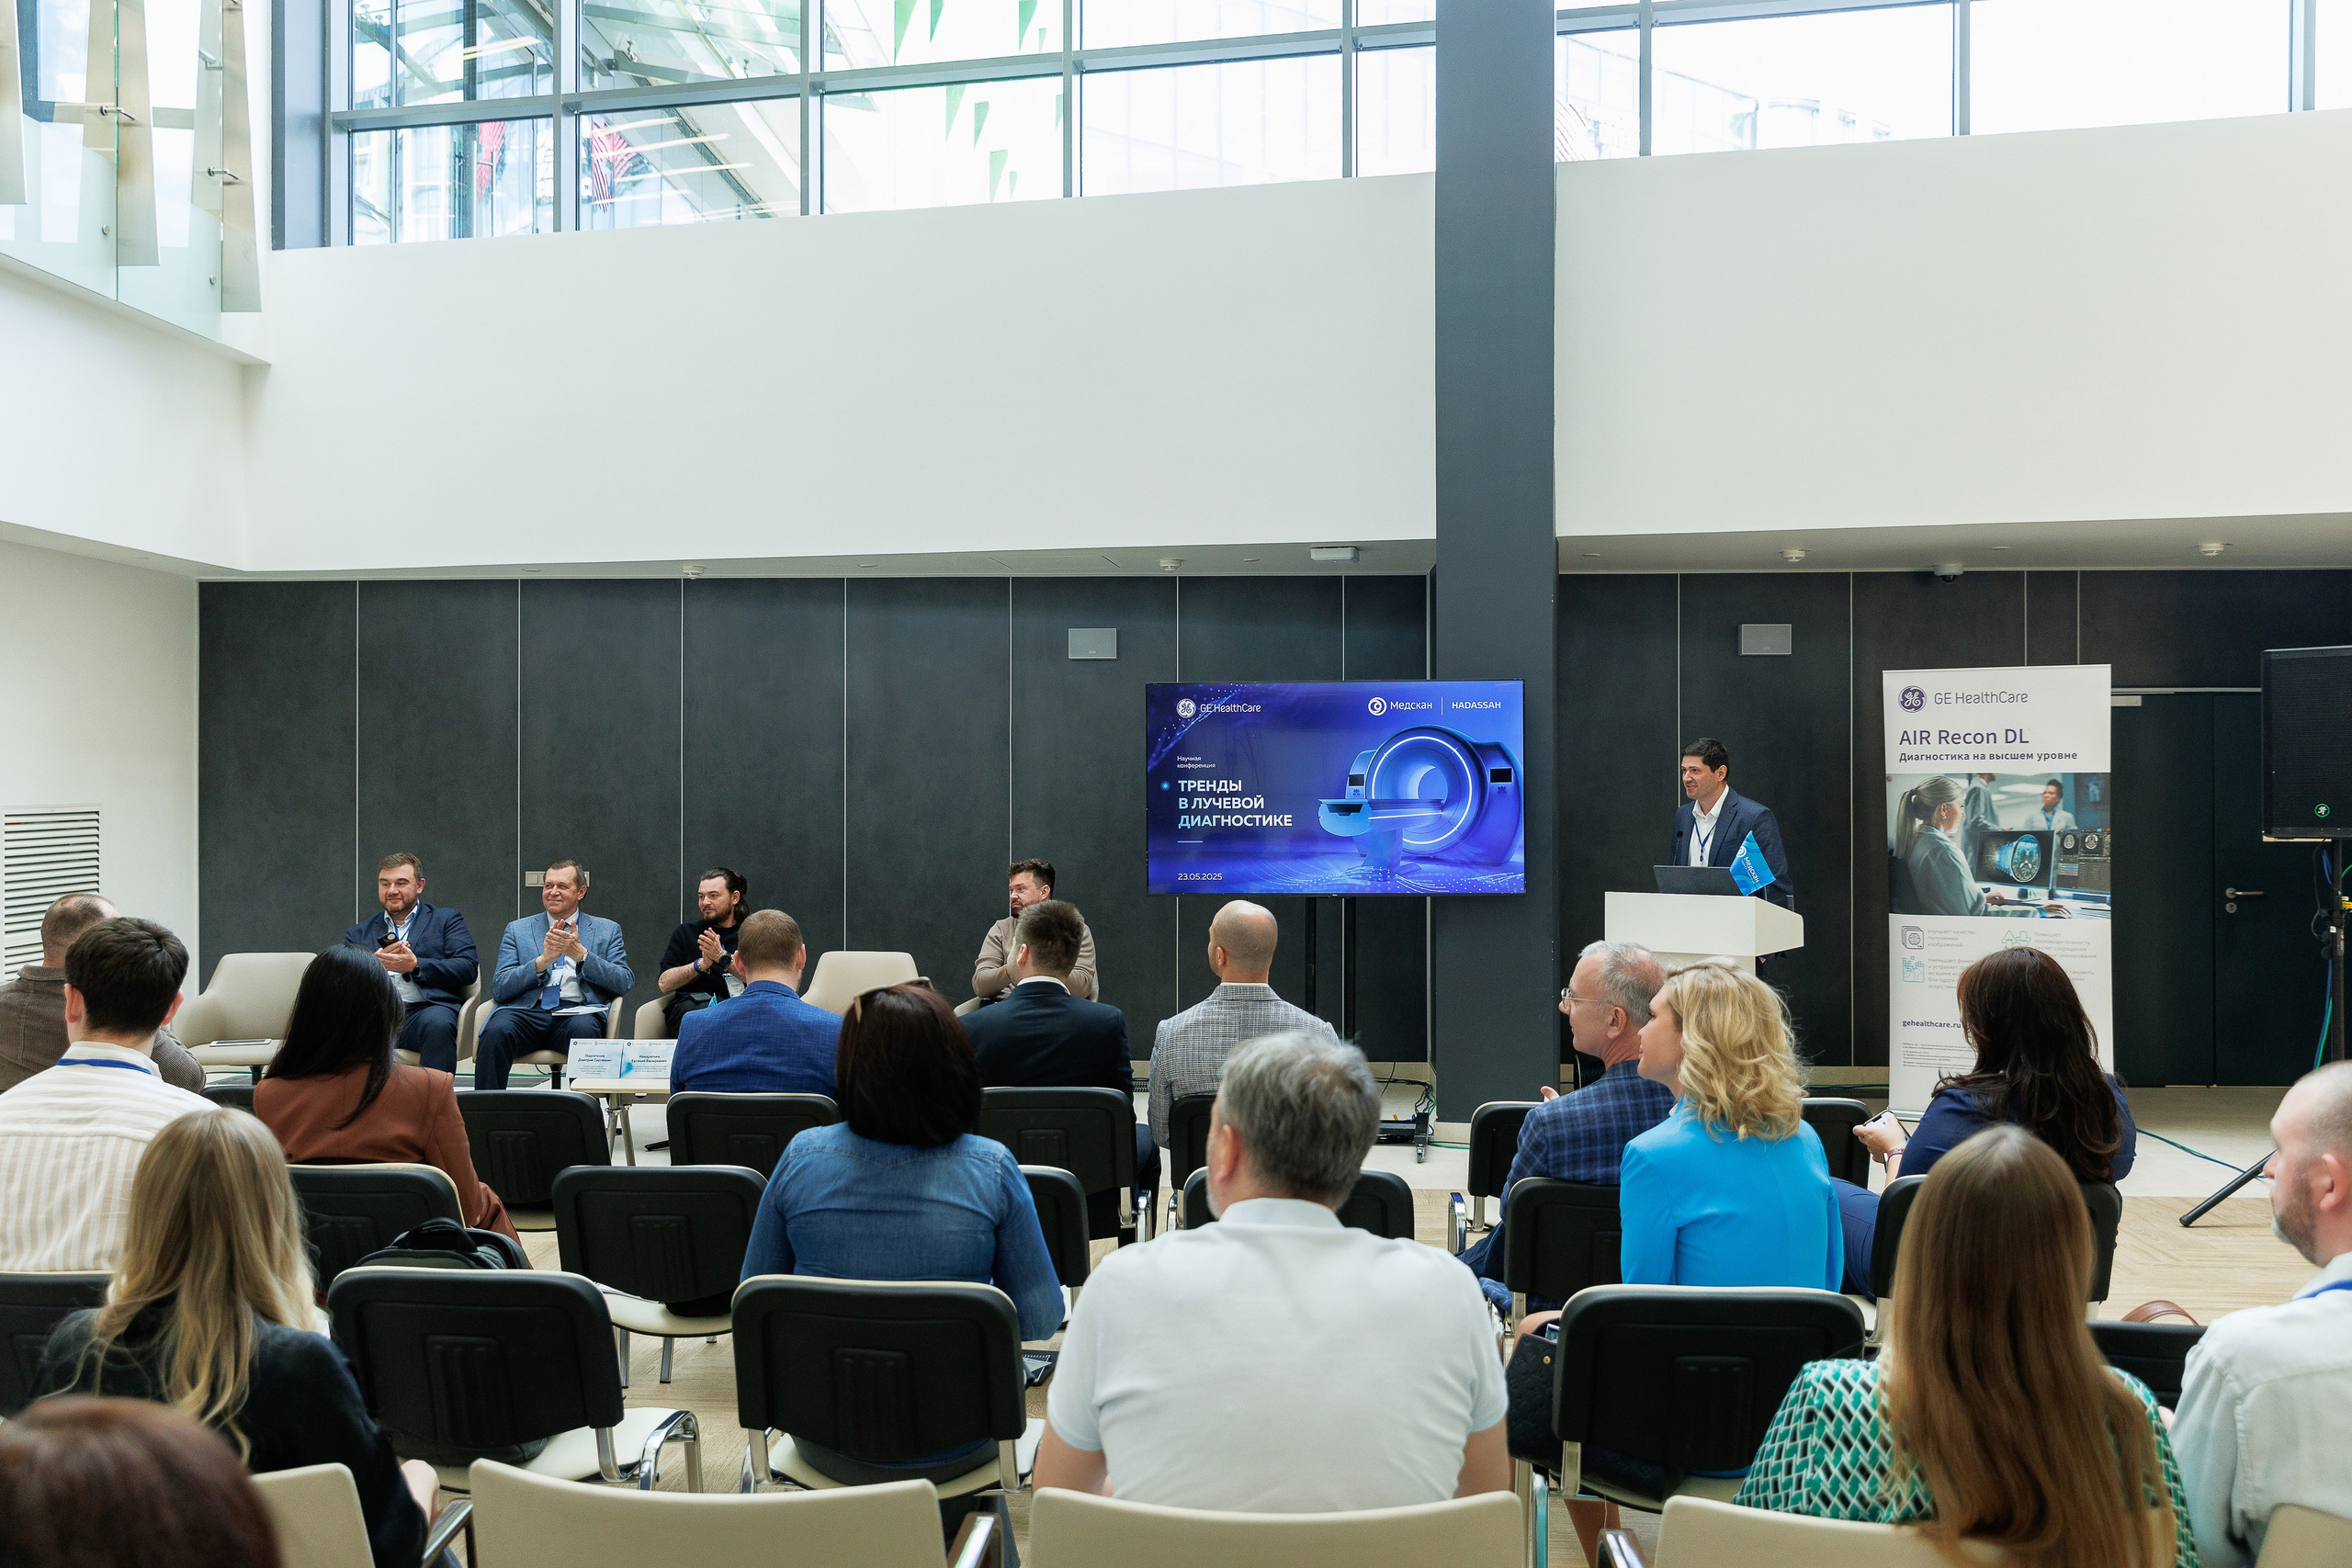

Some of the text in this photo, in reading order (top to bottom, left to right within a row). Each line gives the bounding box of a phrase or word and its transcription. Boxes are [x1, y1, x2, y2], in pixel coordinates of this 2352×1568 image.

[1934, 691, 2029, 705] GE HealthCare
[1200, 703, 1261, 713] GE HealthCare
[1390, 701, 1433, 711] Медскан
[1452, 701, 1501, 709] HADASSAH
[1899, 728, 2030, 745] AIR Recon DL
[1899, 752, 1970, 762] Диагностика
[1989, 752, 2034, 761] высшем
[2037, 751, 2078, 761] уровне
[1178, 780, 1242, 794] ТРЕНДЫ
[1179, 795, 1265, 809] В ЛУЧЕВОЙ
[1178, 815, 1293, 829] ДИАГНОСТИКЕ
[1744, 856, 1759, 883] Медскан
[1177, 873, 1223, 881] 23.05.2025
[1902, 1020, 1962, 1029] gehealthcare.ru
